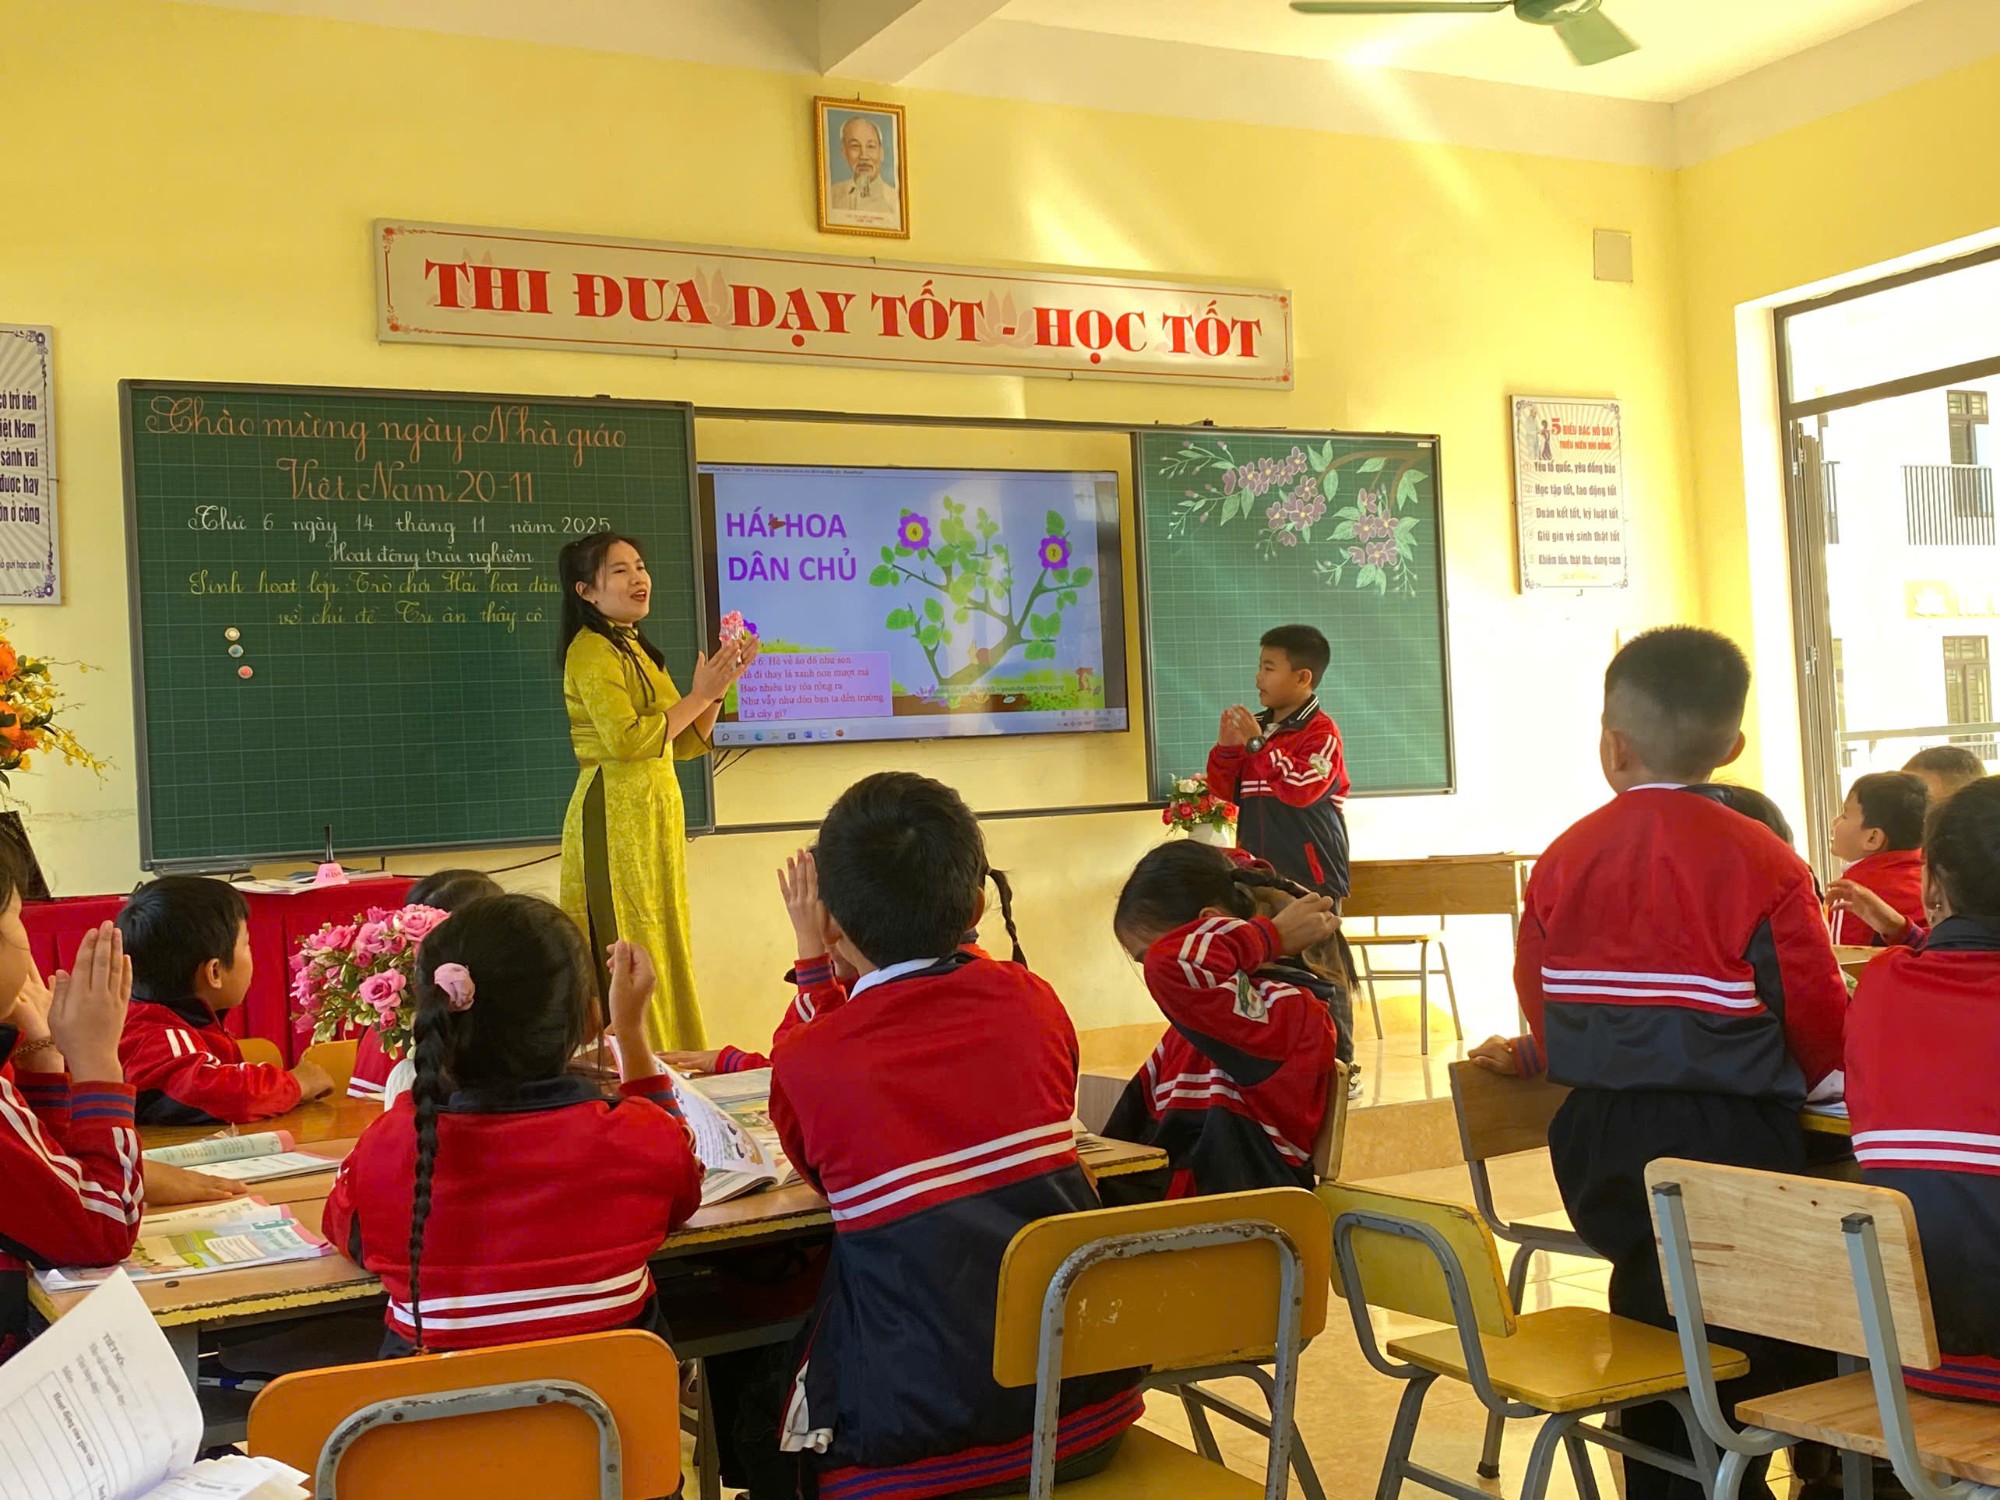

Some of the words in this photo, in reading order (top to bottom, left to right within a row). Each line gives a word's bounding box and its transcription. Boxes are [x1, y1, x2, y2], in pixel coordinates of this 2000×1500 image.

[425, 258, 553, 314] THI
[572, 273, 713, 324] ĐUA
[729, 284, 857, 347] DẠY
[871, 279, 985, 341] TỐT
[1033, 307, 1147, 364] HỌC
[1162, 300, 1262, 357] TỐT
[9, 388, 20, 409] trở
[22, 390, 37, 410] nên
[0, 417, 12, 442] iệt
[14, 419, 36, 438] Nam
[145, 396, 254, 435] Chào
[262, 411, 371, 462] mừng
[378, 417, 466, 464] ngày
[472, 405, 562, 445] Nhà
[567, 423, 627, 468] giáo
[1551, 418, 1561, 435] 5
[0, 447, 22, 466] sánh
[25, 448, 38, 466] vai
[23, 474, 39, 496] hay
[356, 461, 450, 502] Nam
[19, 502, 40, 524] công
[726, 506, 775, 537] HÁI
[785, 513, 847, 538] HOA
[263, 512, 274, 531] 6
[291, 516, 338, 543] ngày
[356, 513, 374, 531] 14
[395, 511, 456, 544] tháng
[473, 516, 485, 533] 11
[509, 520, 555, 533] năm
[561, 517, 611, 534] 2025
[1577, 531, 1592, 541] sinh
[728, 550, 790, 581] DÂN
[799, 547, 857, 581] CHỦ
[489, 571, 519, 592] hoa
[442, 606, 468, 623] ân
[526, 606, 544, 623] cô
